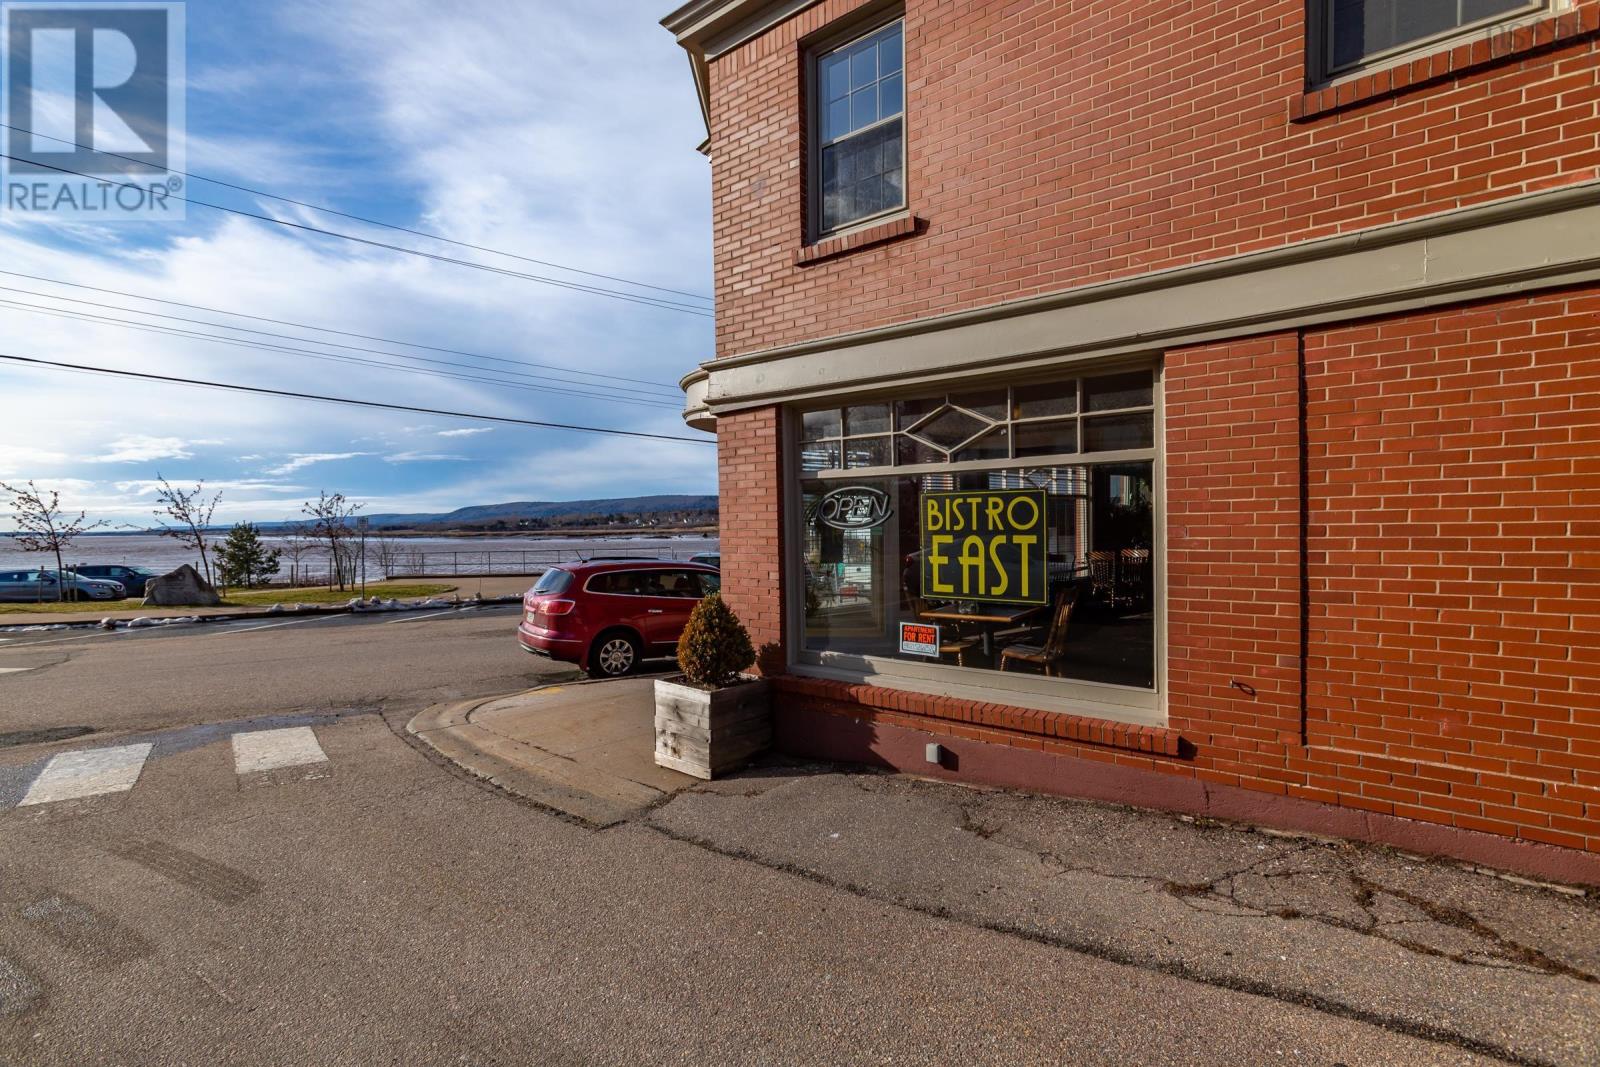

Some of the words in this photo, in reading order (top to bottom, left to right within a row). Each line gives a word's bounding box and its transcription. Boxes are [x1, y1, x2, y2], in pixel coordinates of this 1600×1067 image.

[821, 495, 889, 519] OPEN
[927, 496, 1039, 530] BISTRO
[928, 535, 1038, 597] EAST
[904, 632, 916, 641] FOR
[918, 633, 935, 644] RENT
